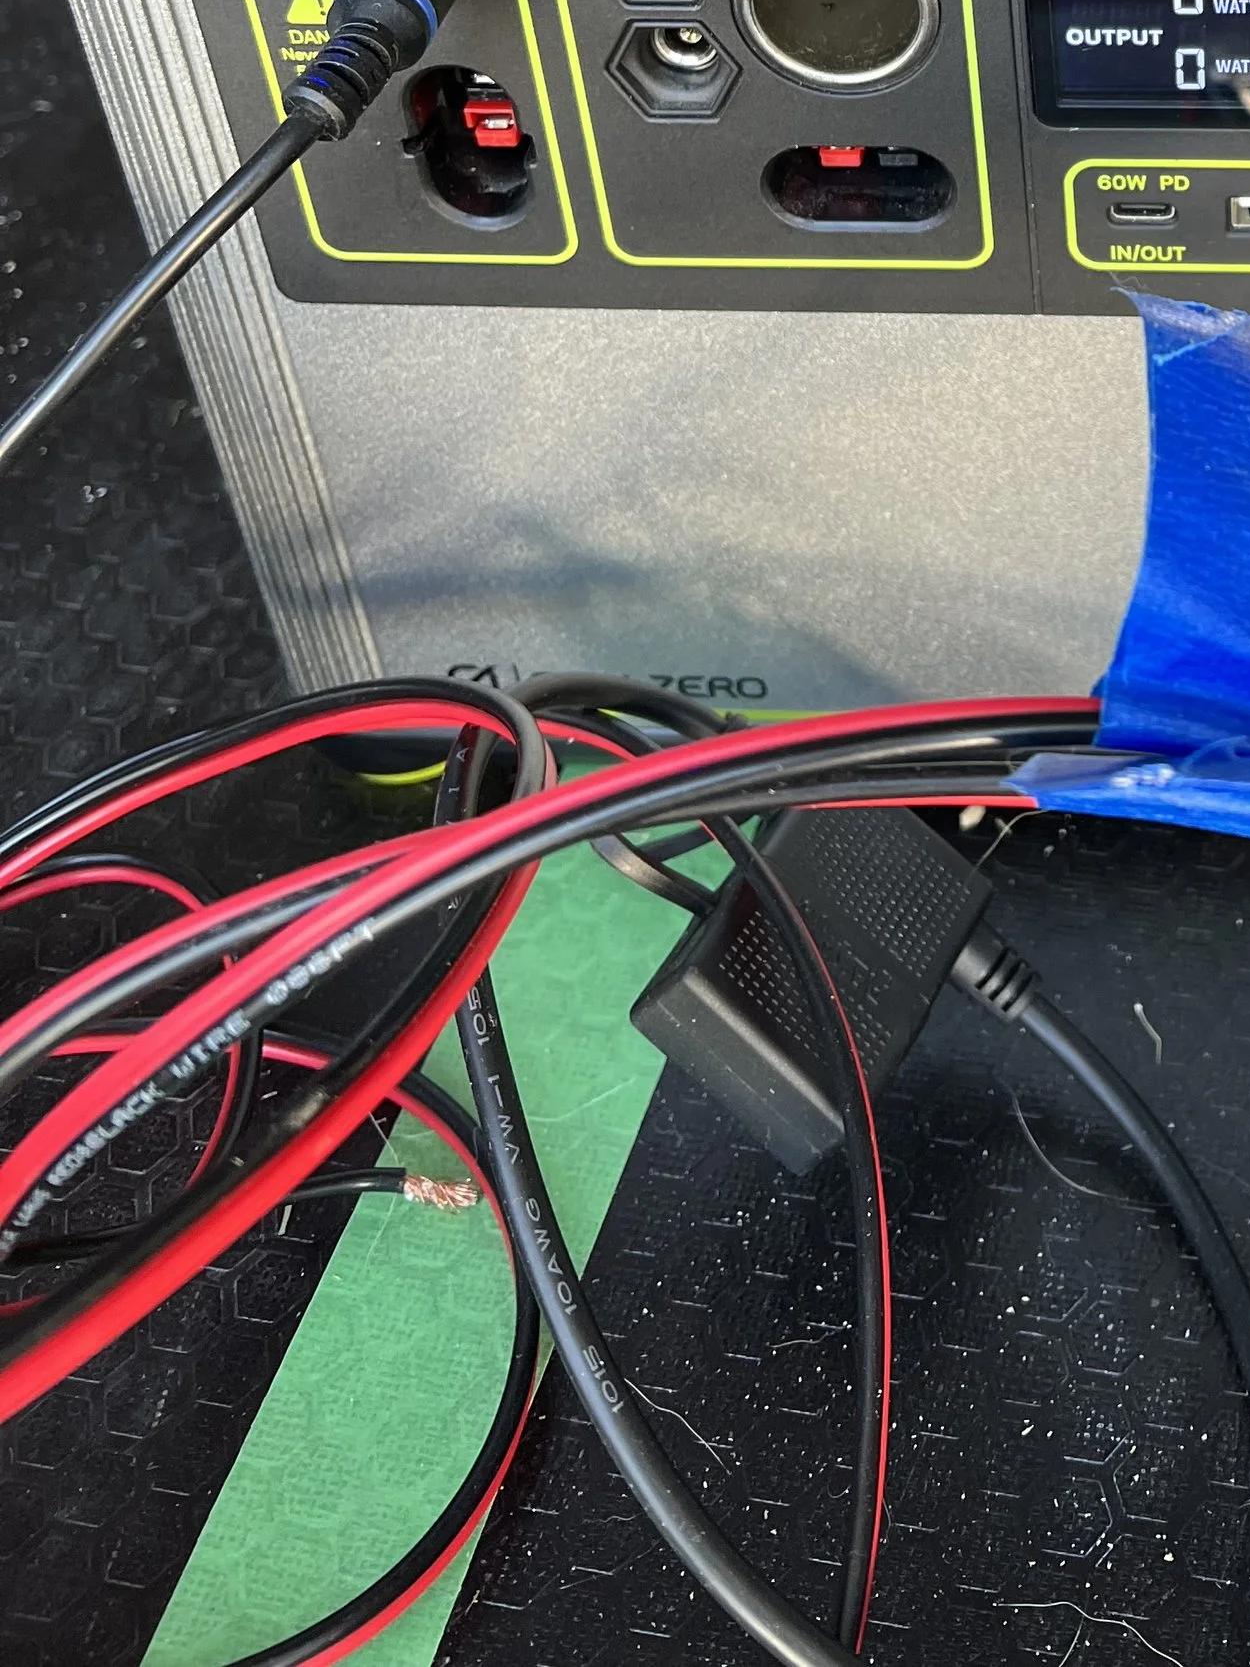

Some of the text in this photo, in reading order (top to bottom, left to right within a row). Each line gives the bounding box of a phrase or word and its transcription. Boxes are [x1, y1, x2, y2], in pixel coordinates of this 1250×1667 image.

[288, 29, 331, 45] DAN
[1065, 29, 1164, 47] OUTPUT
[1175, 47, 1206, 90] 0
[1097, 175, 1190, 192] 60W PD
[1110, 245, 1187, 263] IN/OUT
[525, 1197, 578, 1315] 10AWG
[583, 1344, 625, 1414] 1015
